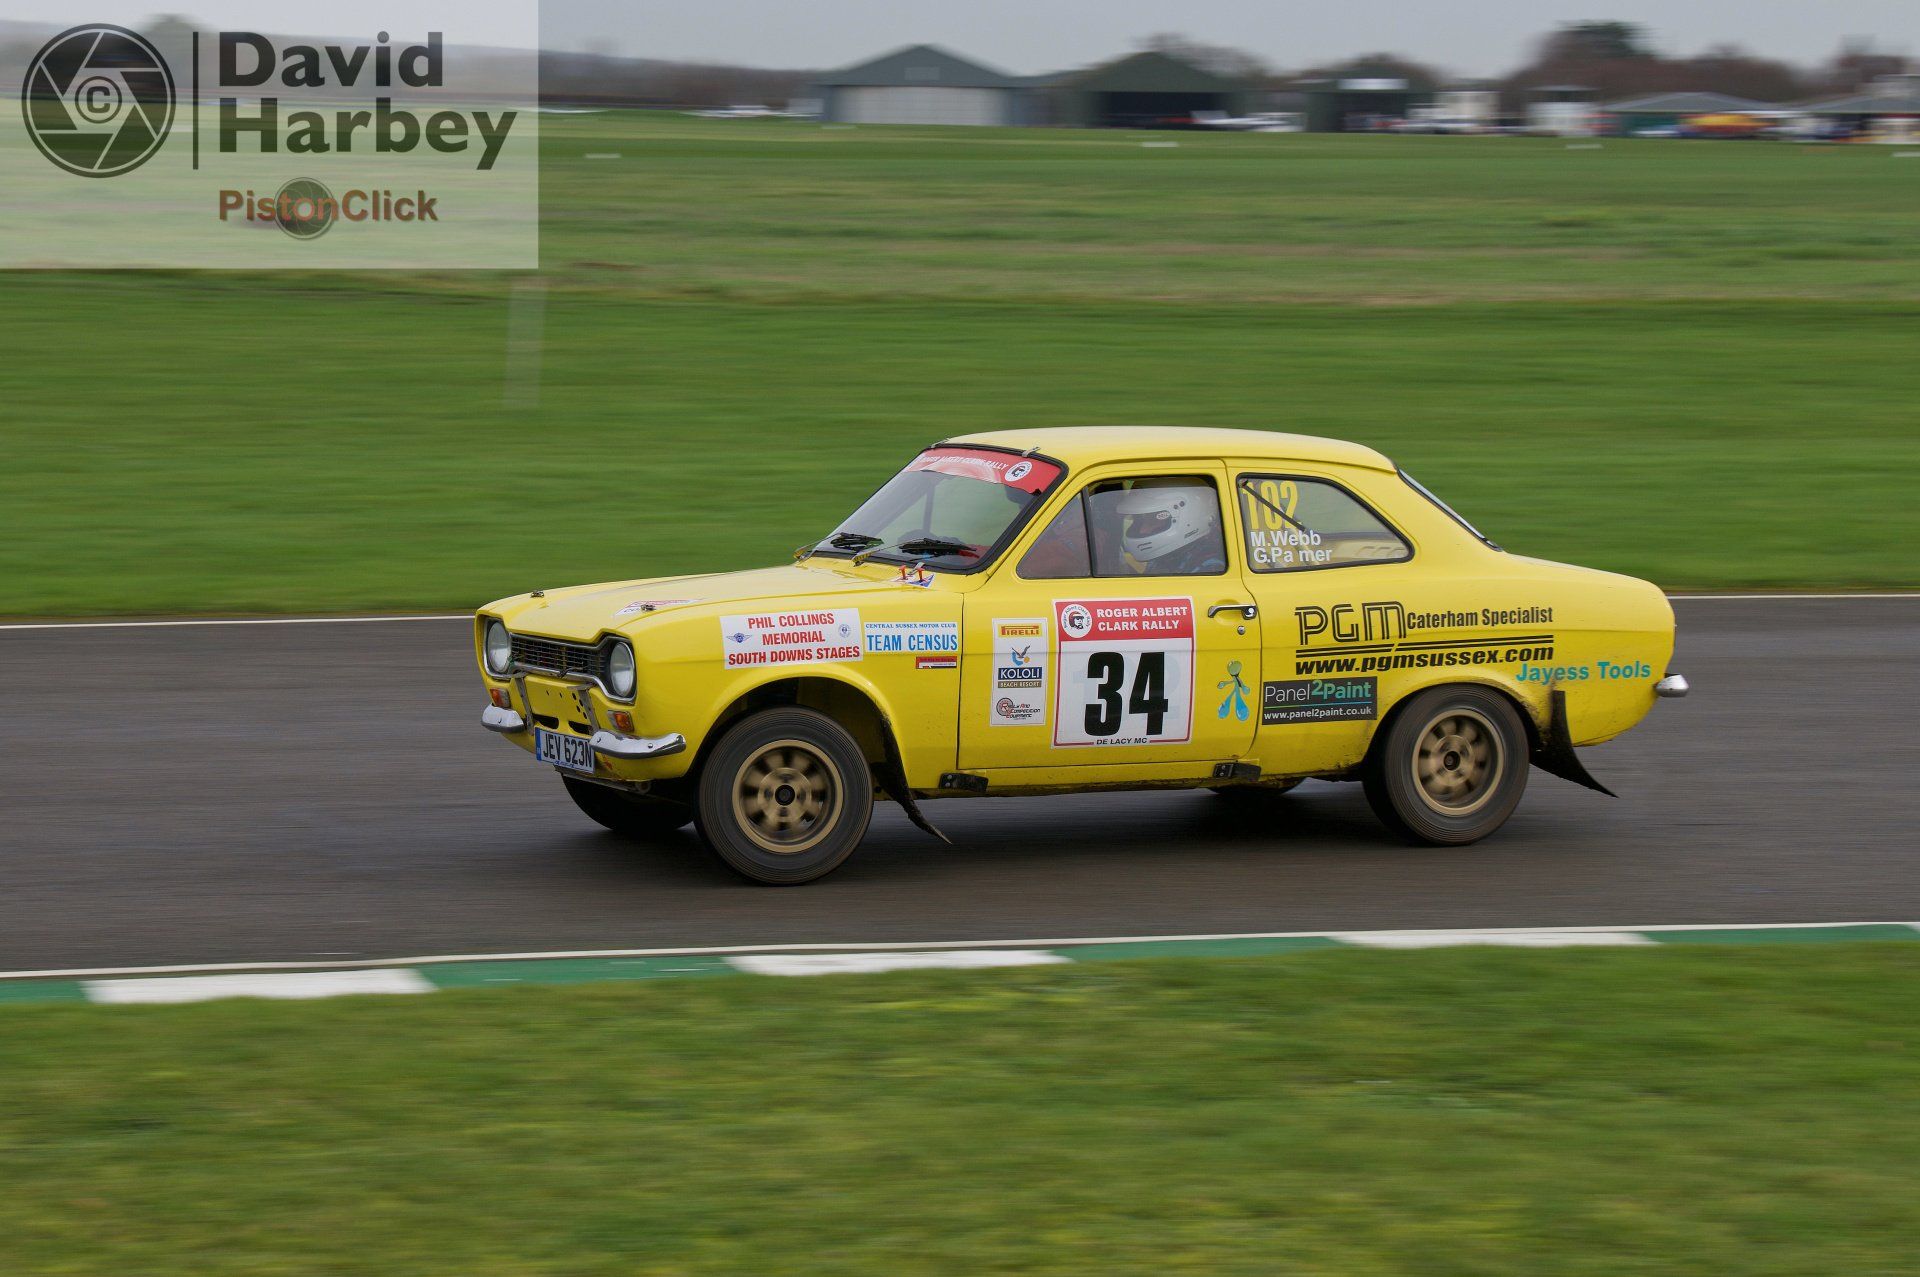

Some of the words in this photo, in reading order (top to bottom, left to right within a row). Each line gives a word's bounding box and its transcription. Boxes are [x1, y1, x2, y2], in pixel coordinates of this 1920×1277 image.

[1240, 480, 1303, 530] 102
[1250, 530, 1322, 547] M.Webb
[1254, 548, 1332, 564] G.Pamer
[748, 617, 776, 629] PHIL
[778, 612, 835, 628] COLLINGS
[1096, 607, 1138, 618] ROGER
[1142, 606, 1188, 617] ALBERT
[1407, 610, 1479, 630] Caterham
[1481, 607, 1554, 627] Specialist
[1001, 625, 1040, 636] PIRELLI
[1098, 621, 1138, 631] CLARK
[1142, 620, 1179, 630] RALLY
[1295, 601, 1407, 646] PGM
[762, 630, 826, 646] MEMORIAL
[866, 634, 902, 651] TEAM
[908, 634, 958, 651] CENSUS
[728, 652, 767, 665] SOUTH
[770, 648, 813, 663] DOWNS
[816, 645, 860, 659] STAGES
[1296, 645, 1554, 675] www.pgmsussex.com
[1000, 668, 1040, 679] KOLOLI
[1515, 663, 1589, 685] Jayess
[1597, 661, 1651, 680] Tools
[1084, 651, 1169, 737] 34
[1264, 679, 1372, 703] Panel2Paint
[1263, 705, 1372, 721] www.panel2paint.co.uk
[543, 732, 561, 760] JEV
[563, 737, 593, 768] 623N
